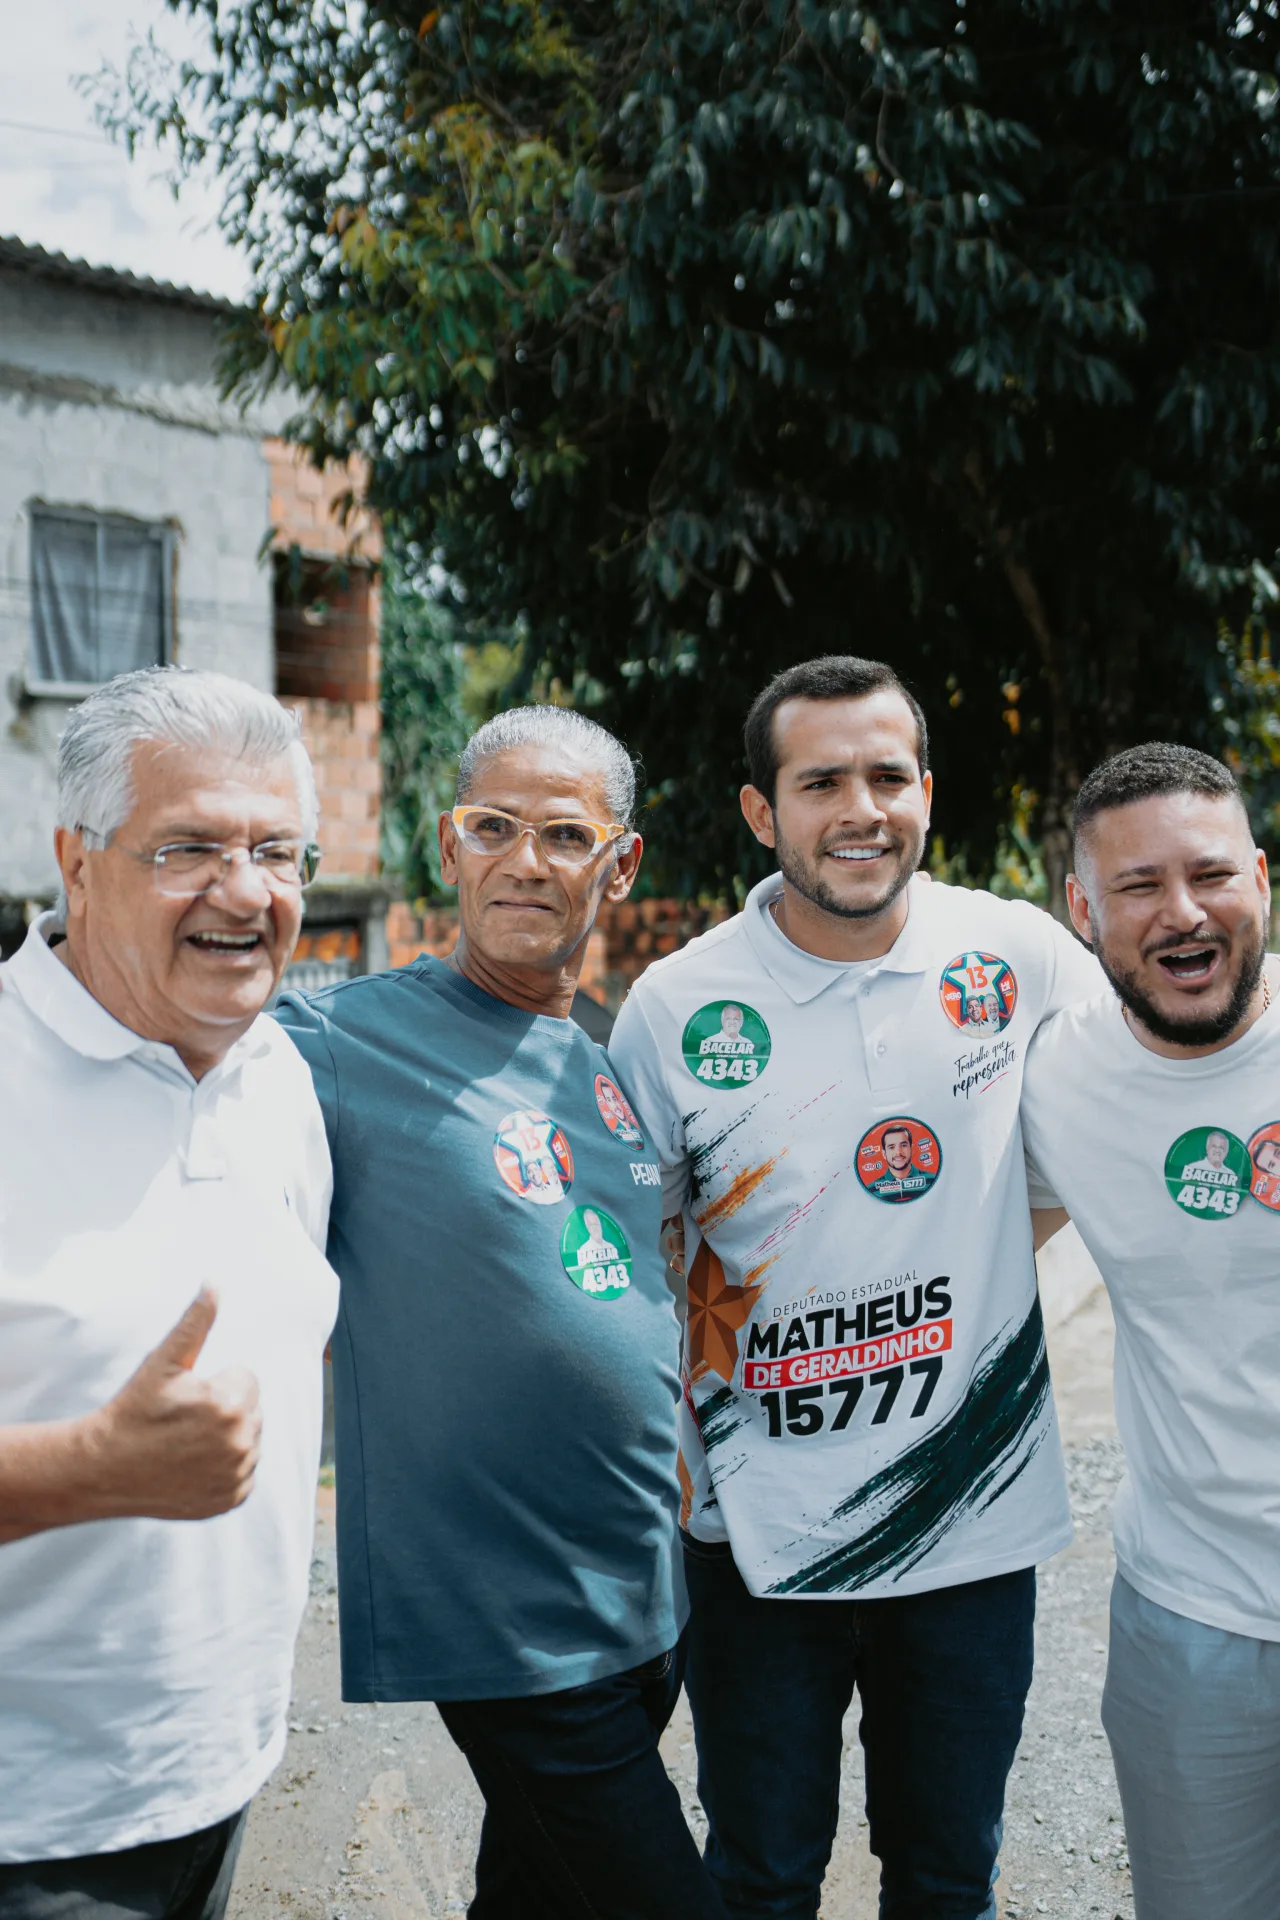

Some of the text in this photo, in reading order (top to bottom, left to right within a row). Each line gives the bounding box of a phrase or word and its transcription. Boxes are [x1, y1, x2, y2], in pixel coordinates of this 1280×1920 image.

[966, 965, 988, 989] 13
[699, 1040, 755, 1054] BACELAR
[954, 1041, 1005, 1077] Trabalho que
[696, 1058, 759, 1081] 4343
[518, 1126, 541, 1151] 13
[875, 1180, 901, 1189] Matheus
[1182, 1165, 1238, 1186] BACELAR
[1177, 1184, 1240, 1214] 4343
[582, 1263, 630, 1292] 4343
[773, 1269, 918, 1318] DEPUTADO ESTADUAL
[746, 1276, 953, 1359] MATHEUS
[753, 1326, 944, 1386] DE GERALDINHO
[760, 1355, 943, 1438] 15777
